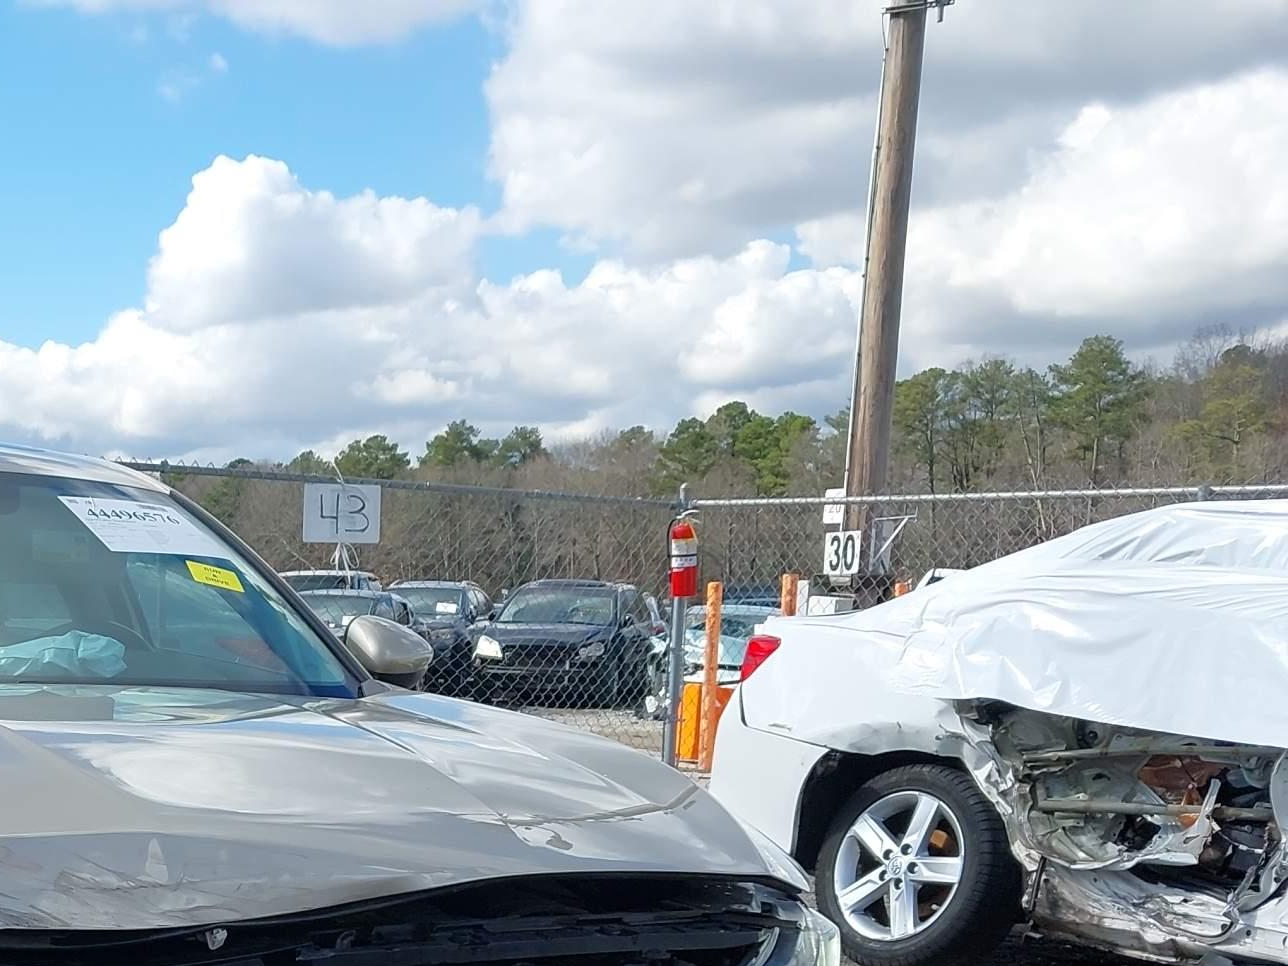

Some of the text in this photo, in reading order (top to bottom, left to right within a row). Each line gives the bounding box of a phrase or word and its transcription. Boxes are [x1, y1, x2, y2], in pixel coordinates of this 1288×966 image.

[87, 508, 181, 526] 44496576
[320, 493, 370, 535] 43
[829, 535, 856, 572] 30
